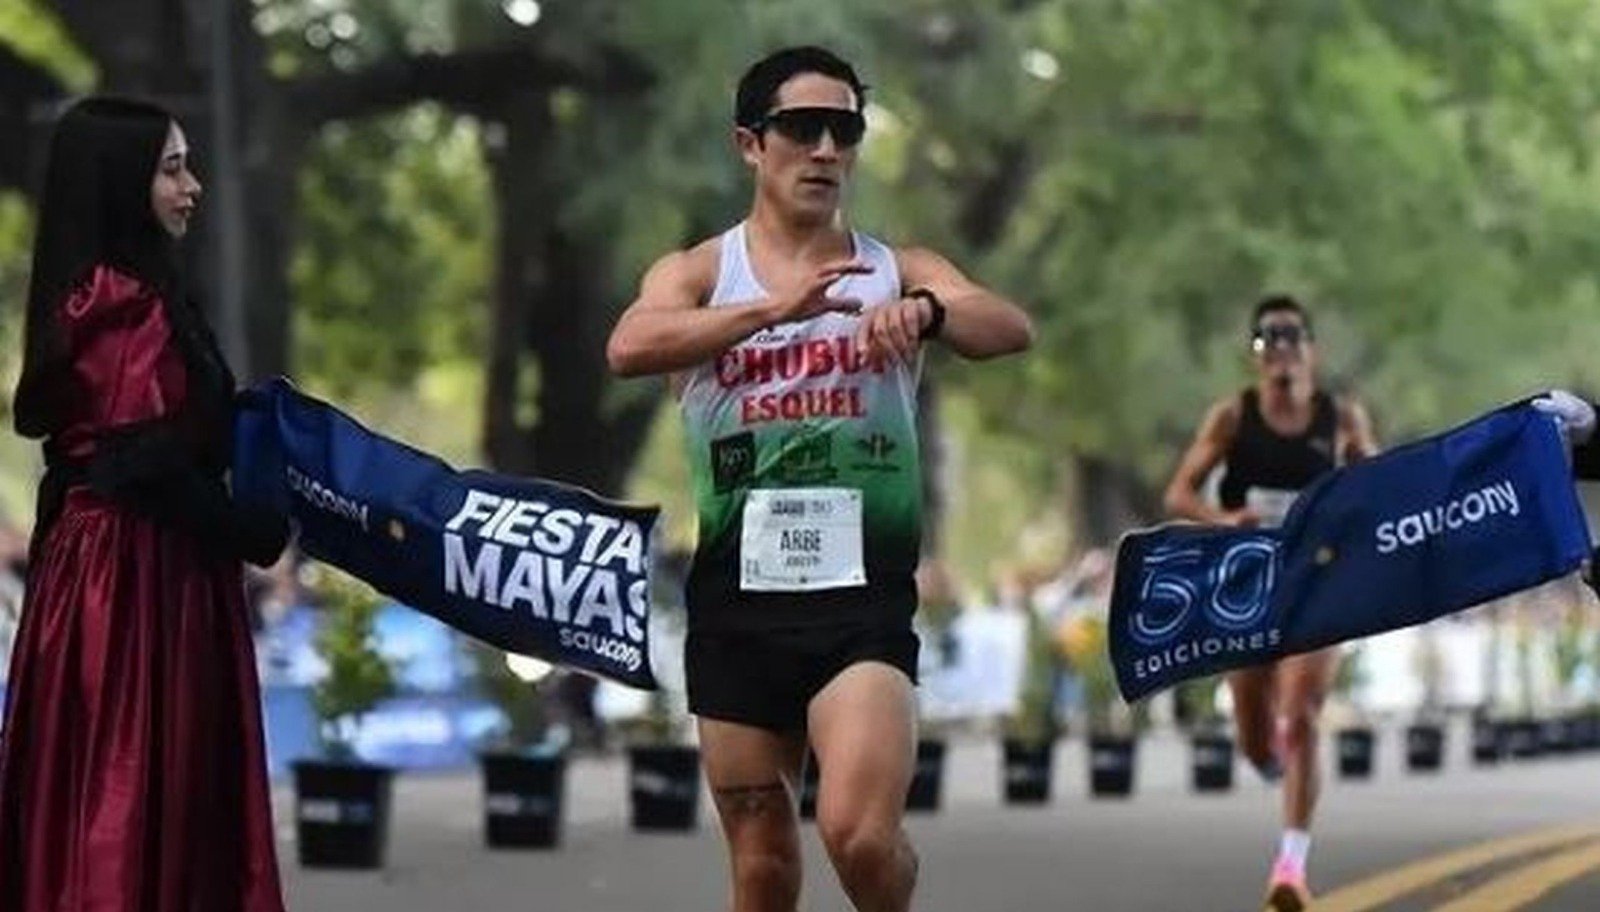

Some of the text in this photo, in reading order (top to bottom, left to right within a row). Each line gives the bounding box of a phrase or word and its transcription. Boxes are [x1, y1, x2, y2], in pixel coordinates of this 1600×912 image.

[715, 335, 886, 389] CHUBU
[741, 388, 867, 425] ESQUEL
[446, 489, 648, 573] FIESTA
[1375, 480, 1520, 553] saucony
[443, 532, 648, 642] MAYAS
[1128, 537, 1281, 644] 50
[558, 627, 642, 672] saucony
[1134, 628, 1282, 679] EDICIONES
